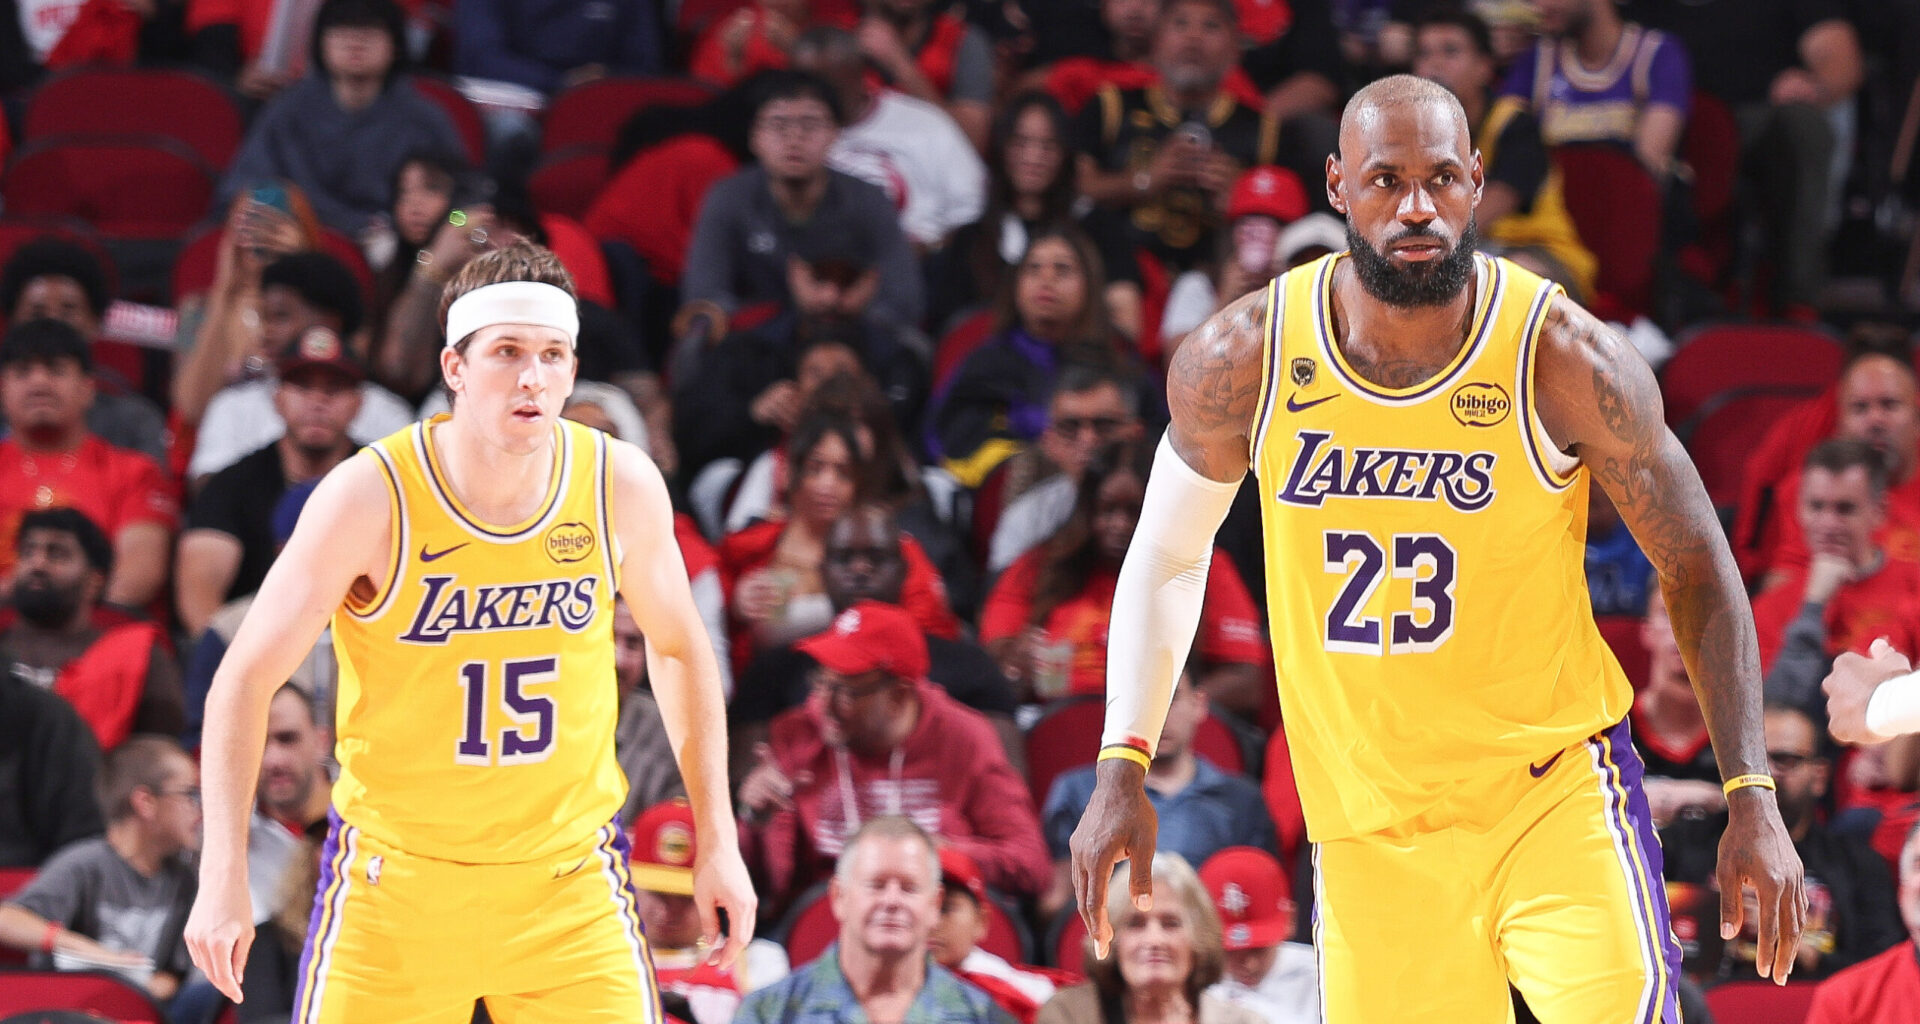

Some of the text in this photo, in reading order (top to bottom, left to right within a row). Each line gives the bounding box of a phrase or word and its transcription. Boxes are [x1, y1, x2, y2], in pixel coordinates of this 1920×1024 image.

[1456, 394, 1507, 415] bibigo
[1276, 430, 1498, 513] LAKERS
[550, 532, 592, 551] bibigo
[397, 575, 599, 645] LAKERS
[1323, 530, 1457, 656] 23
[456, 655, 559, 766] 15
